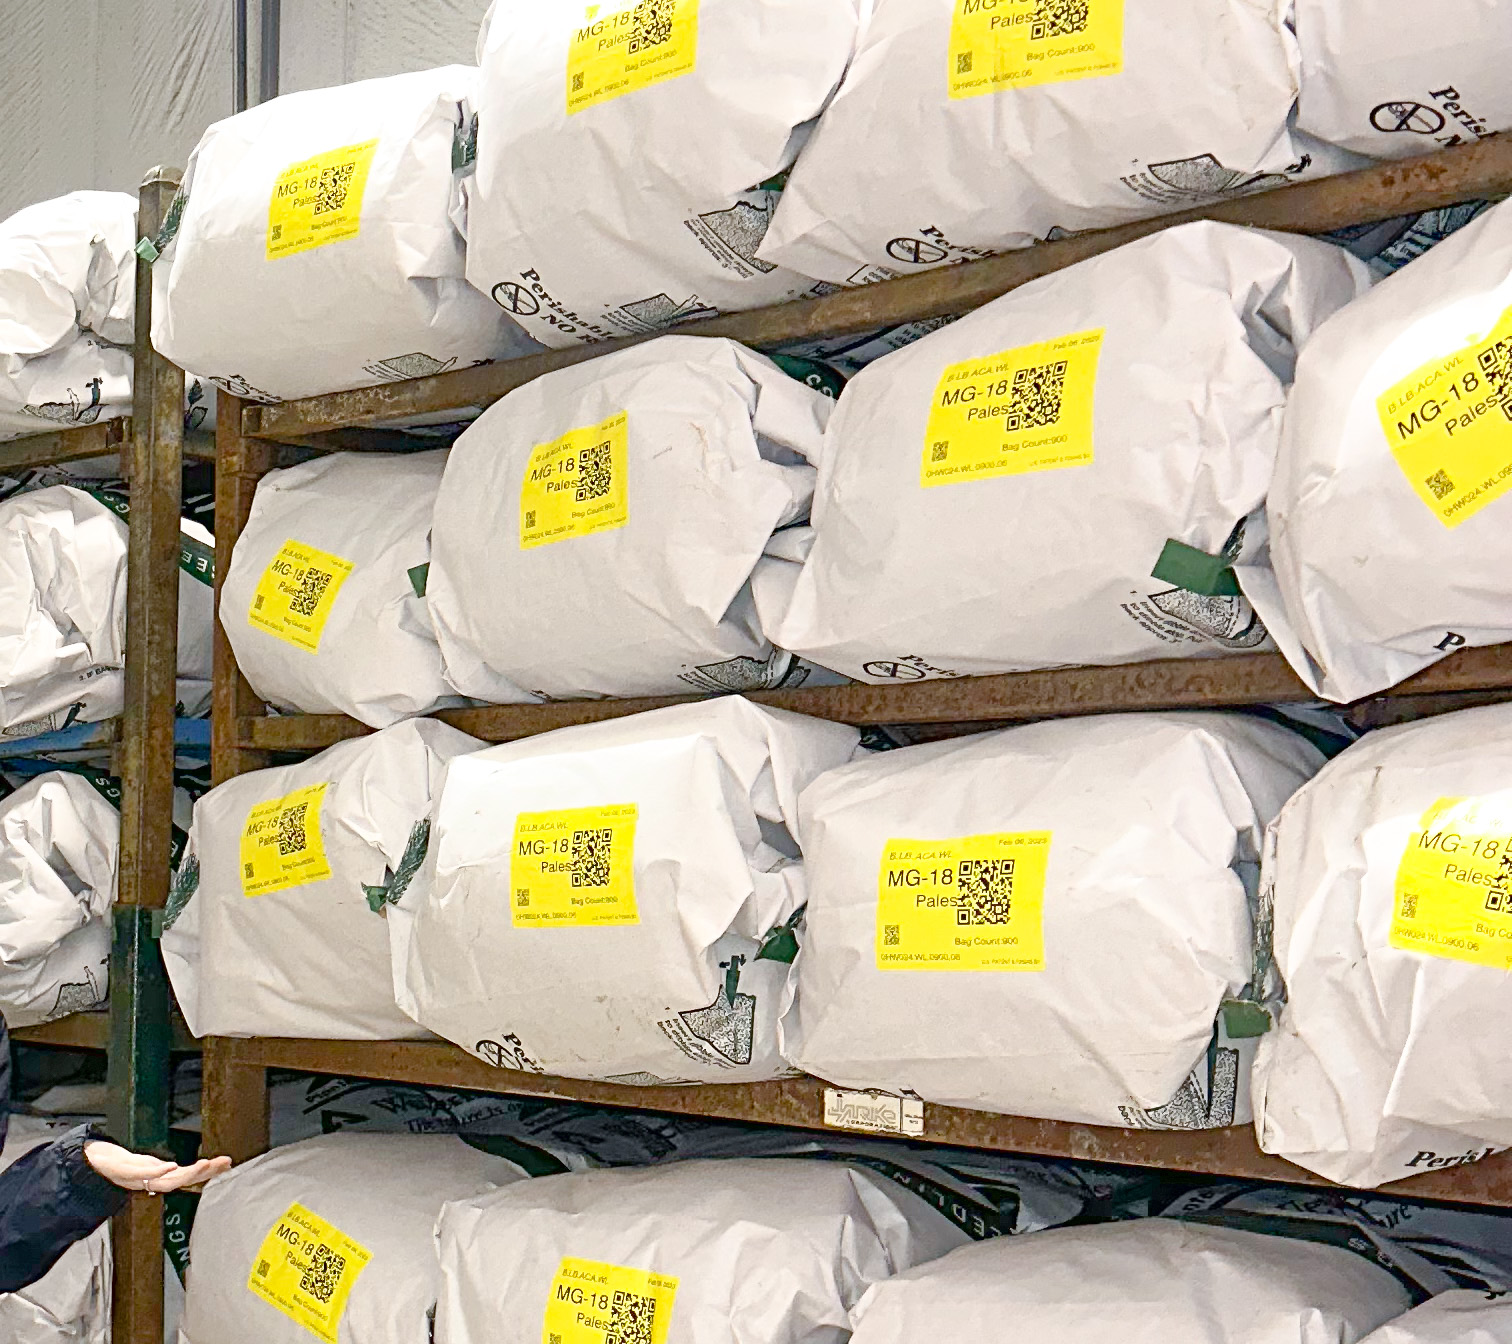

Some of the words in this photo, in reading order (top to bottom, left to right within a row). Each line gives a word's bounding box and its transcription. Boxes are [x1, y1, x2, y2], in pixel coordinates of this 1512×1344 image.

[576, 11, 629, 43] MG-18
[277, 176, 318, 198] MG-18
[540, 313, 578, 335] NO
[941, 379, 1007, 406] MG-18
[1397, 371, 1479, 440] MG-18
[530, 458, 575, 483] MG-18
[271, 559, 304, 581] MG-18
[246, 816, 280, 836] MG-18
[518, 838, 570, 856] MG-18
[1418, 829, 1499, 860] MG-18
[888, 868, 953, 887] MG-18
[1476, 923, 1495, 937] Bag
[954, 937, 972, 947] Bag
[276, 1223, 315, 1256] MG-18
[556, 1284, 610, 1310] MG-18
